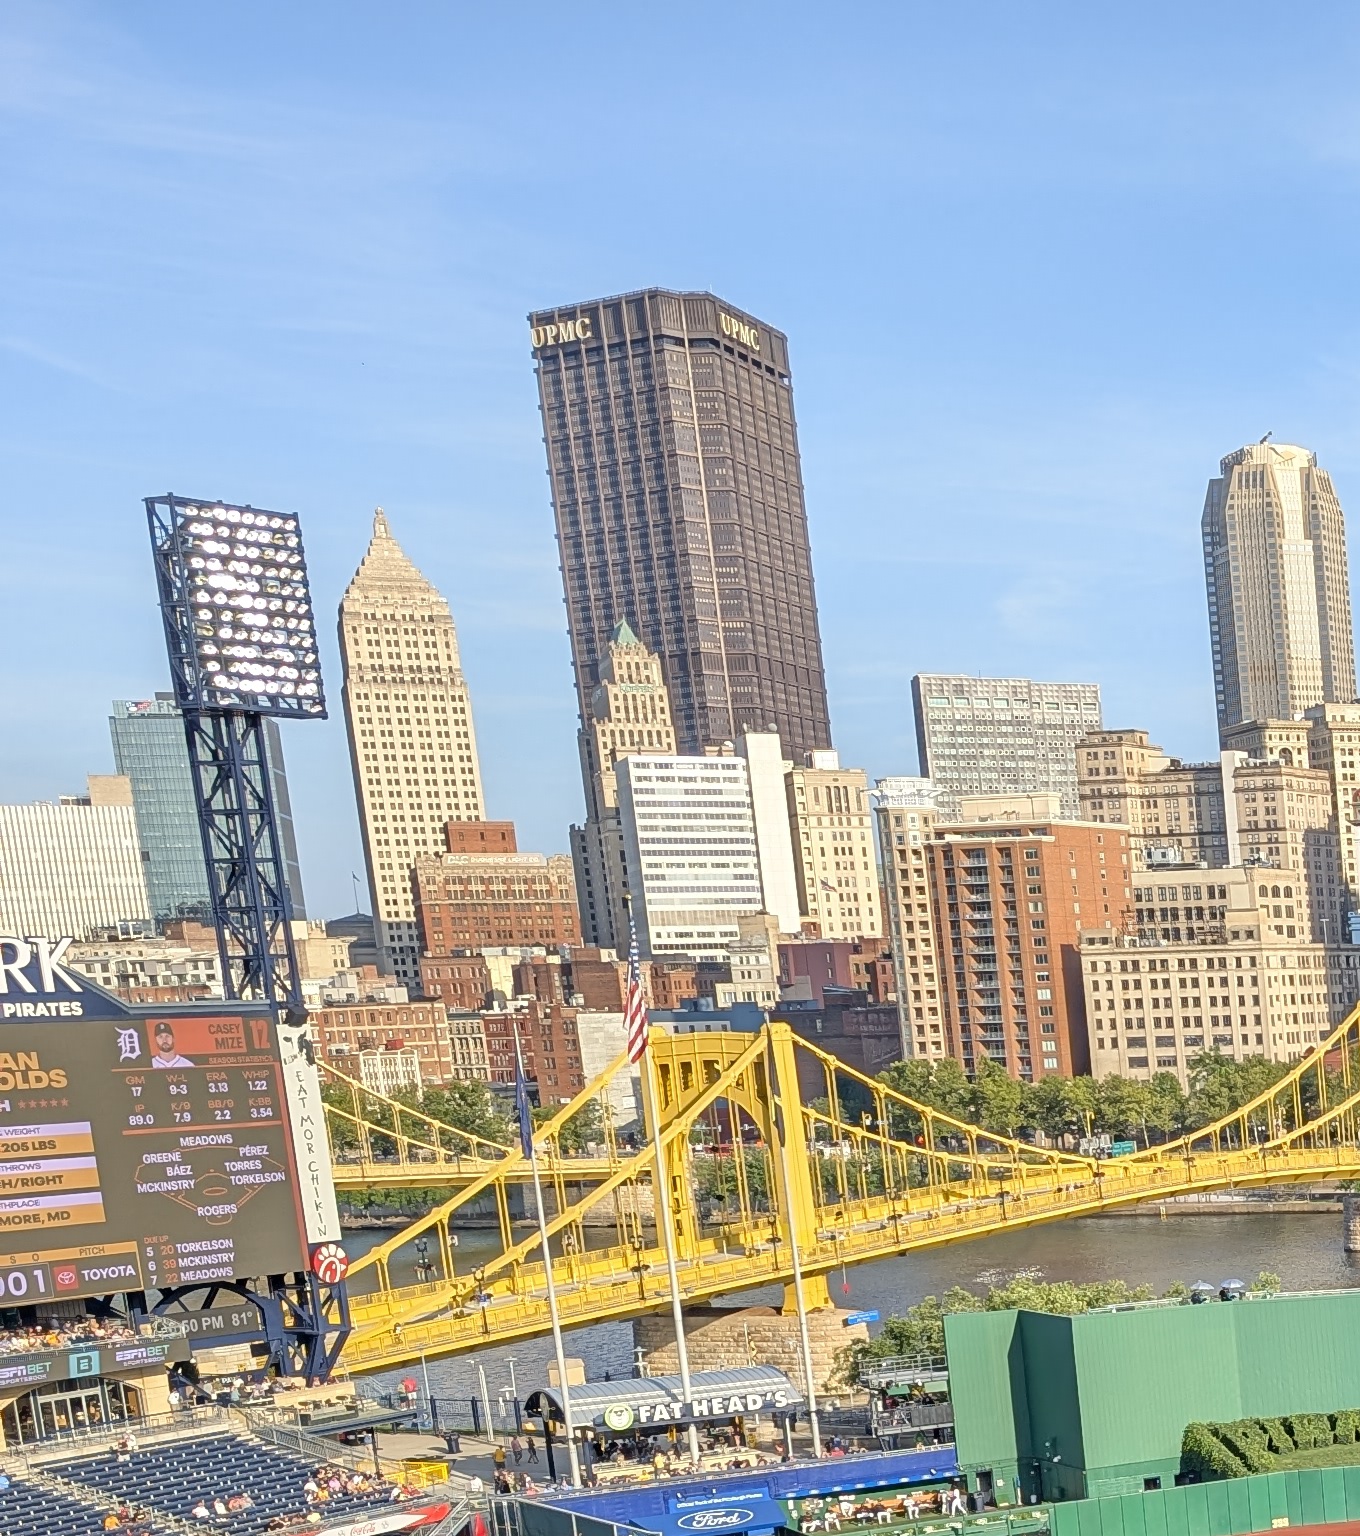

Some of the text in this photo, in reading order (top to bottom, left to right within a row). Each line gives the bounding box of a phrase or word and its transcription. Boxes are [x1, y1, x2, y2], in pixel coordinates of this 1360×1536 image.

[530, 317, 592, 348] UPMC
[719, 311, 760, 351] UPMC
[2, 1001, 83, 1017] PIRATES
[208, 1024, 240, 1035] CASEY
[214, 1037, 244, 1050] MIZE
[125, 1076, 145, 1085] GM
[206, 1072, 227, 1081] ERA
[242, 1070, 270, 1079] WHIP
[131, 1080, 268, 1096] 17 9-3 3.13 1.22
[134, 1104, 145, 1113] IP
[129, 1107, 273, 1126] 89.0 7.9 2.2 3.54
[2, 1140, 56, 1152] 205 LBS
[180, 1133, 233, 1147] MEADOWS
[143, 1151, 182, 1164] GREENE
[239, 1145, 269, 1157] PÉREZ
[296, 1071, 327, 1237] EAT MOR CHIKIN
[1, 1162, 41, 1172] THROWS
[166, 1165, 193, 1177] BÁEZ
[225, 1160, 262, 1172] TORRES
[137, 1179, 195, 1193] MCKINSTRY
[230, 1172, 286, 1186] TORKELSON
[47, 1211, 71, 1221] MD
[197, 1203, 237, 1217] ROGERS
[79, 1246, 105, 1256] PITCH
[146, 1239, 233, 1256] 5 20 TORKELSON
[148, 1252, 235, 1271] 6 39 MCKINSTRY
[81, 1265, 136, 1281] TOYOTA
[150, 1266, 233, 1285] 7 22 MEADOWS
[202, 1311, 253, 1330] PM 81°
[147, 1345, 170, 1356] BET
[27, 1362, 51, 1374] BET
[638, 1390, 788, 1423] FAT HEAD'S
[692, 1511, 740, 1528] Ford
